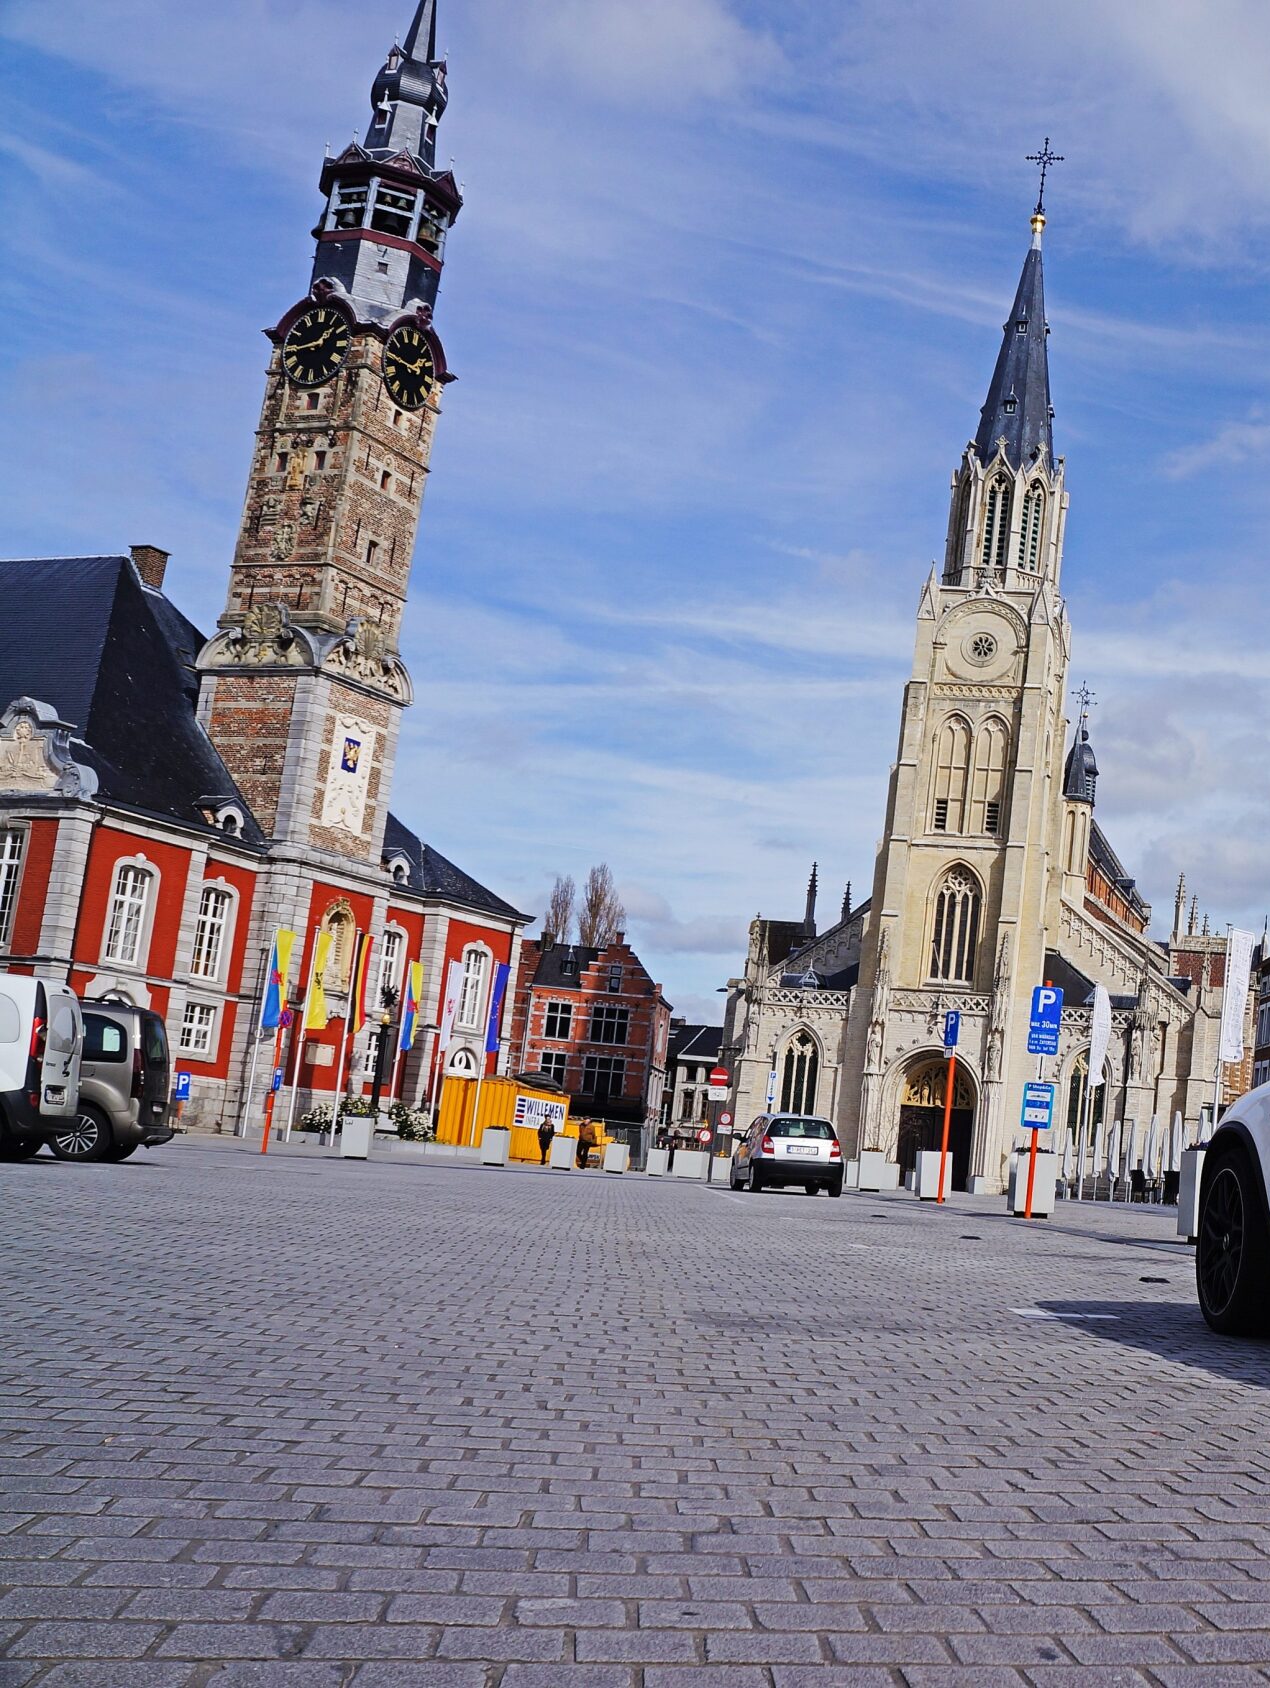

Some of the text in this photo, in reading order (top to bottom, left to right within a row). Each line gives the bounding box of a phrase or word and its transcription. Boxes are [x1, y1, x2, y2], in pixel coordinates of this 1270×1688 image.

[1038, 989, 1056, 1013] P
[947, 1013, 956, 1032] P
[178, 1075, 189, 1091] P
[526, 1100, 565, 1121] WILLEMEN
